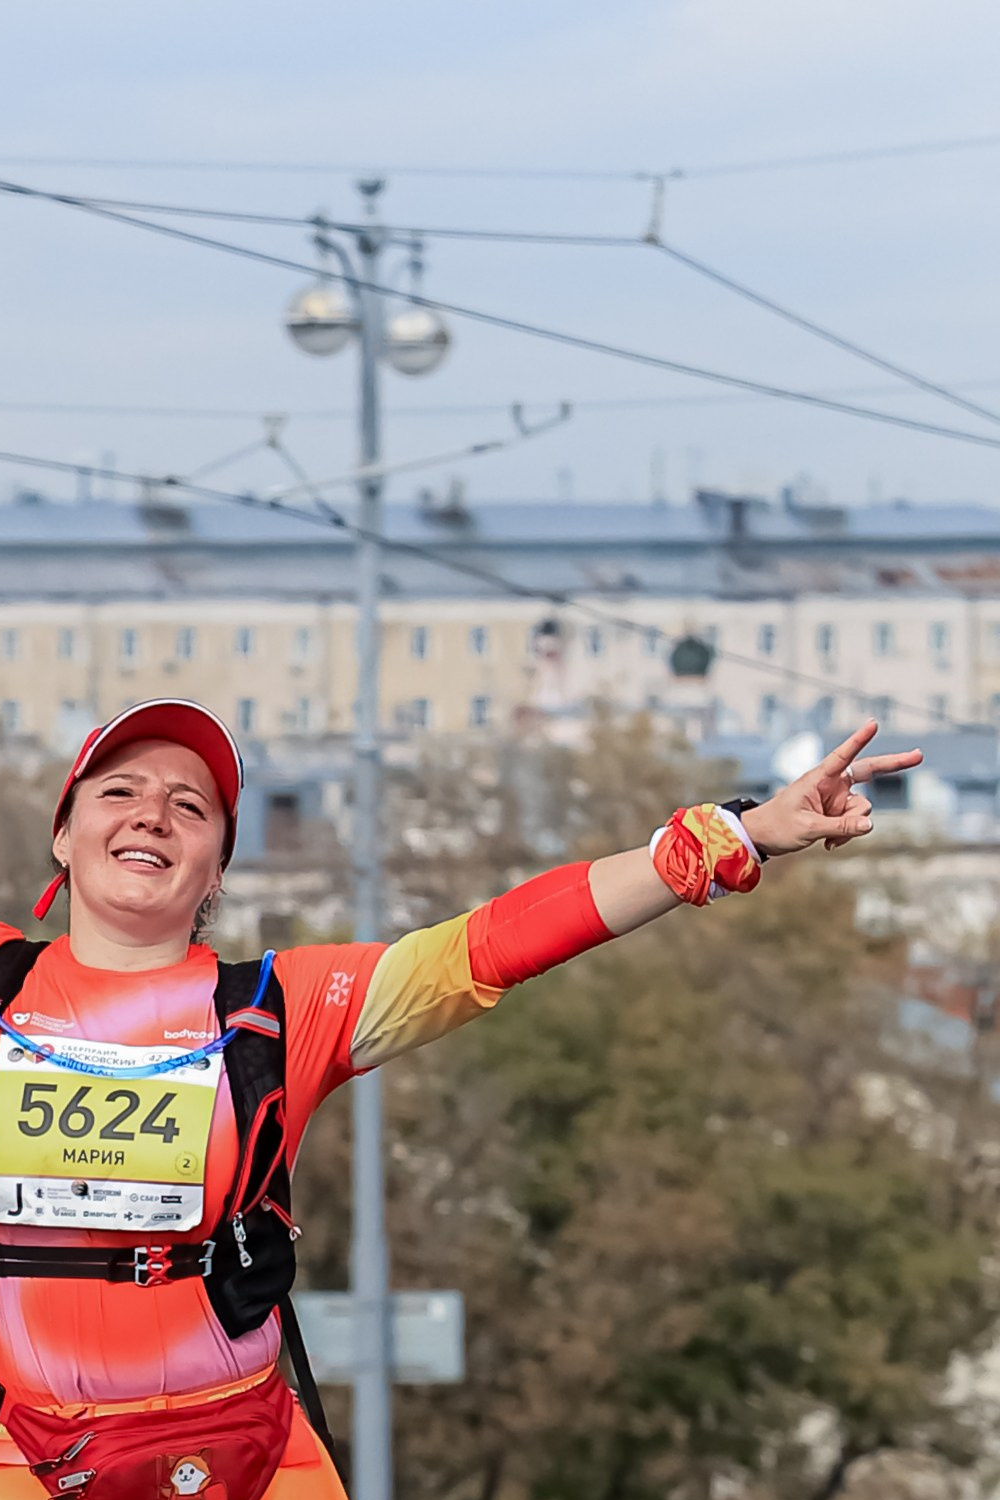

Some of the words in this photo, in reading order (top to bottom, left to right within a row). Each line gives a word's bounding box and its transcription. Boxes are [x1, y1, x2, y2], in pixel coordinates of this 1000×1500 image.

[18, 1082, 180, 1144] 5624
[63, 1148, 125, 1166] МАРИЯ
[182, 1158, 191, 1168] 2
[7, 1183, 23, 1217] J
